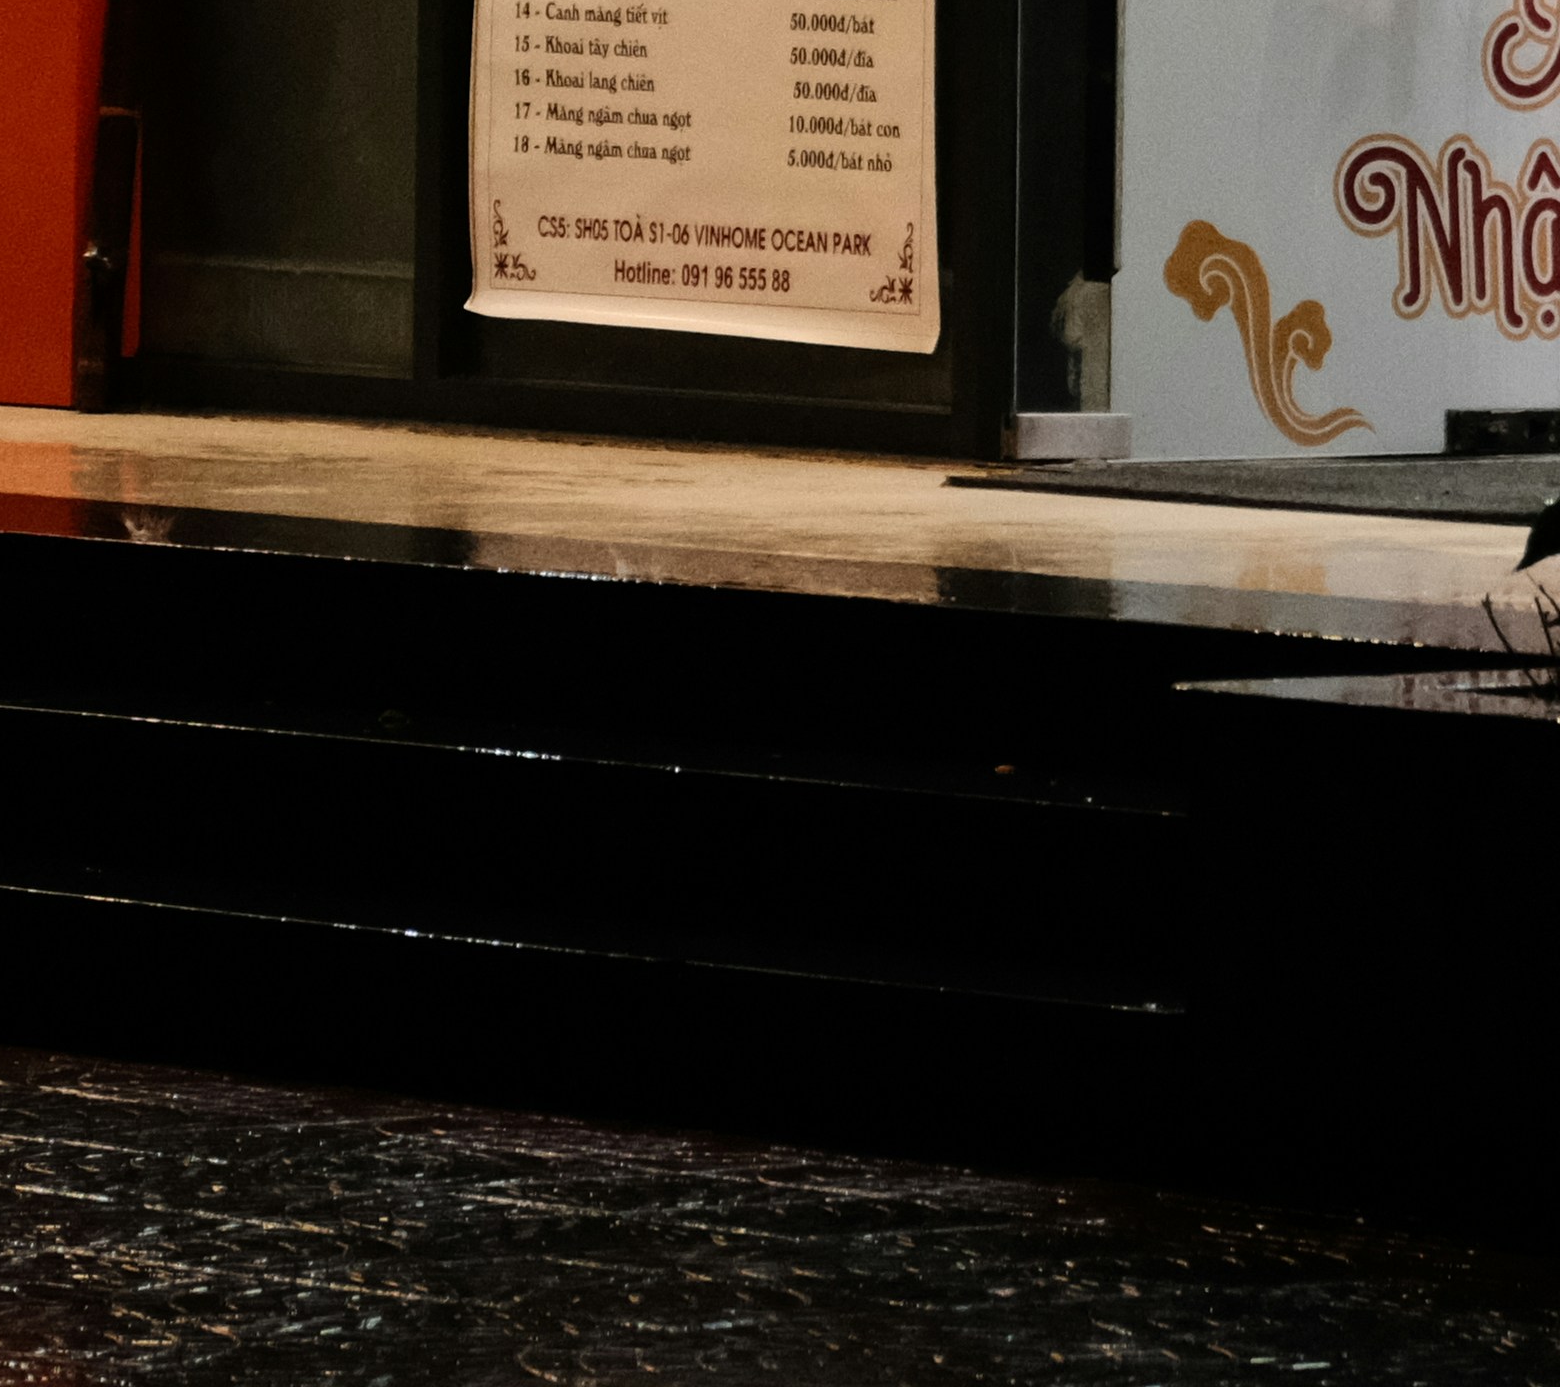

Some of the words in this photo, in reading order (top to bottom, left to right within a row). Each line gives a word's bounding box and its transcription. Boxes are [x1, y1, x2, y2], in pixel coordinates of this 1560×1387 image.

[515, 69, 531, 87] 16
[545, 69, 585, 90] Khoai
[590, 72, 618, 94] lang
[537, 215, 571, 240] CS5:
[575, 217, 609, 242] SH05
[613, 213, 645, 244] TOÀ
[649, 222, 690, 246] S1-06
[695, 224, 766, 251] VINHOME
[772, 229, 828, 254] OCEAN
[833, 232, 872, 257] PARK
[614, 260, 676, 286] Hotline:
[681, 267, 709, 288] 091
[715, 269, 733, 290] 96
[739, 269, 766, 291] 555
[772, 270, 791, 292] 88
